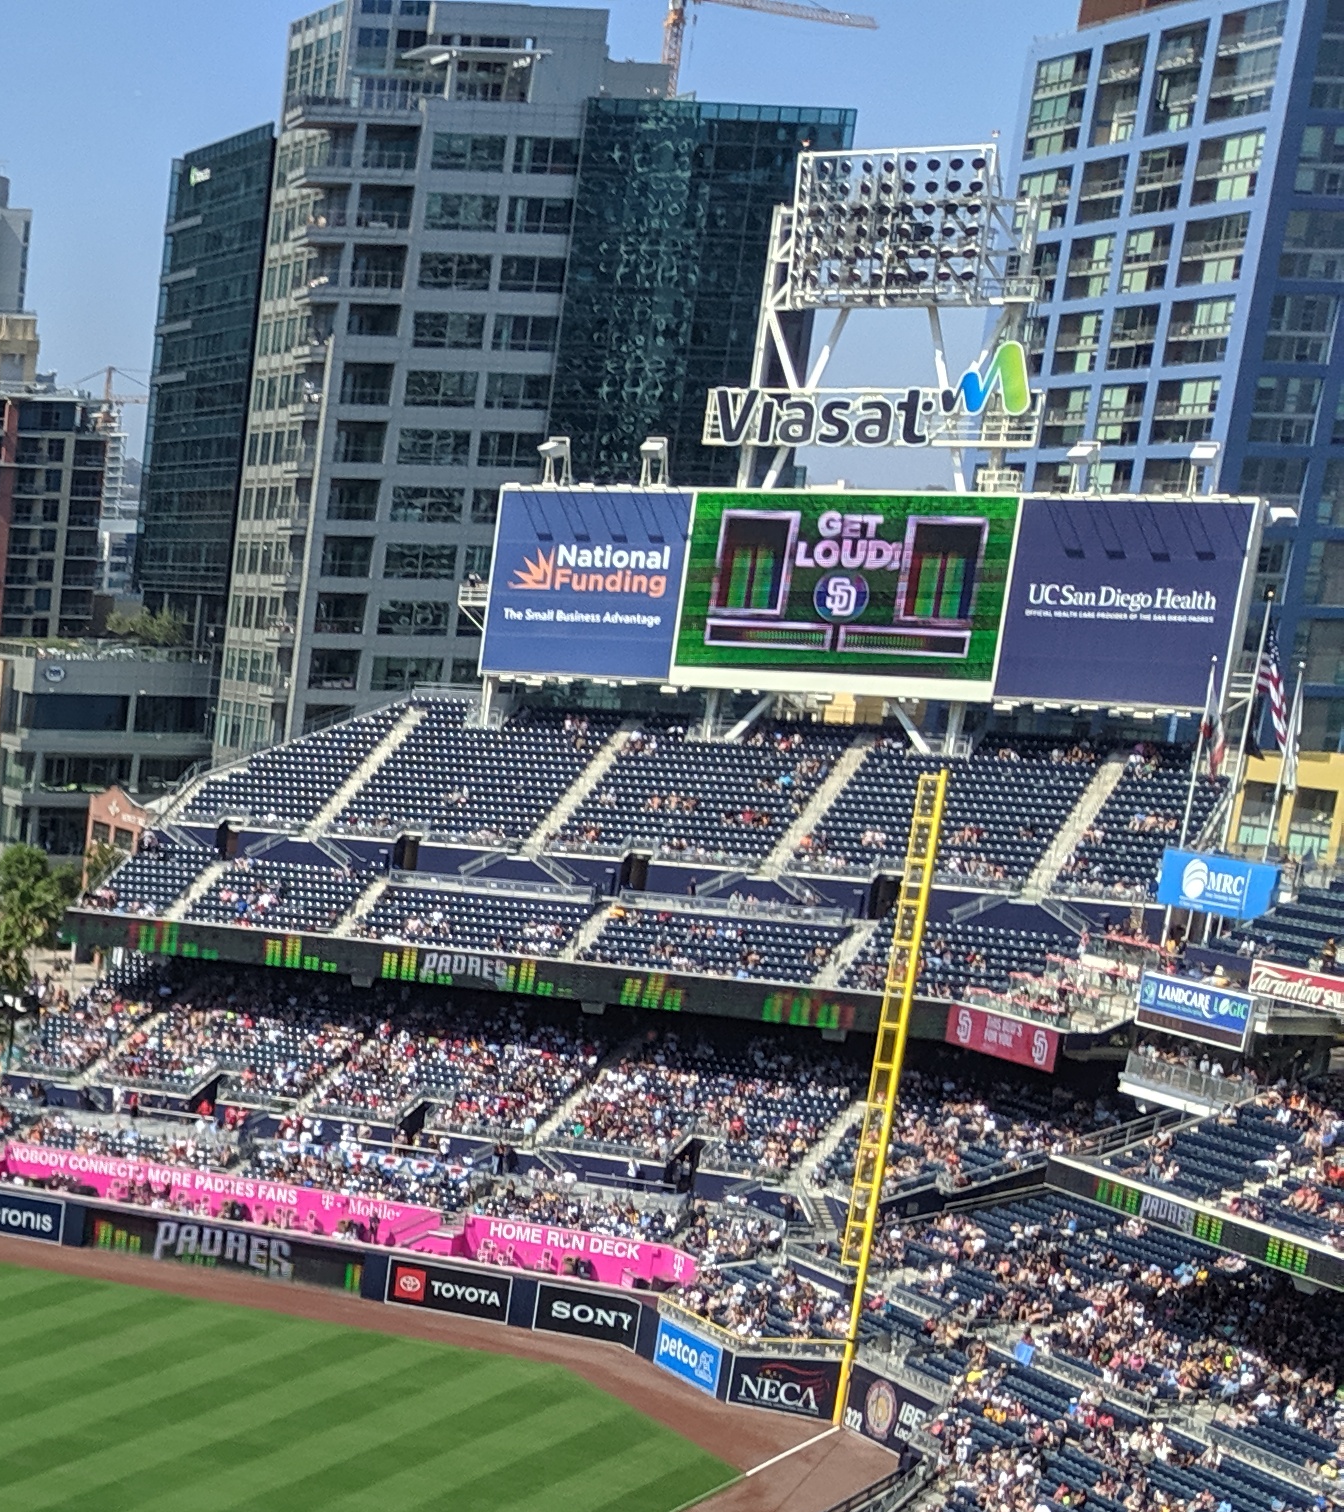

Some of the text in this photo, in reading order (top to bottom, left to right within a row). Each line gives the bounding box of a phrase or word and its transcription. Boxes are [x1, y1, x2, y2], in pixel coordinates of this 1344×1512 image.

[716, 386, 929, 447] Viasat
[818, 510, 884, 538] GET
[556, 544, 671, 569] National
[554, 568, 667, 598] Funding
[825, 576, 857, 616] SD
[1029, 583, 1216, 612] UC San Diego Health
[503, 607, 662, 628] The Small Business Advantage
[1206, 871, 1245, 896] MRC
[11, 1147, 68, 1169] NOBODY
[147, 1166, 191, 1189] MORE
[257, 1183, 298, 1205] FANS
[154, 1221, 294, 1279] PADRES
[490, 1222, 640, 1261] HOME RUN DECK
[431, 1279, 501, 1308] TOYOTA
[551, 1300, 633, 1332] SONY
[659, 1333, 698, 1368] petco
[738, 1373, 819, 1411] NECA
[844, 1406, 863, 1432] 322
